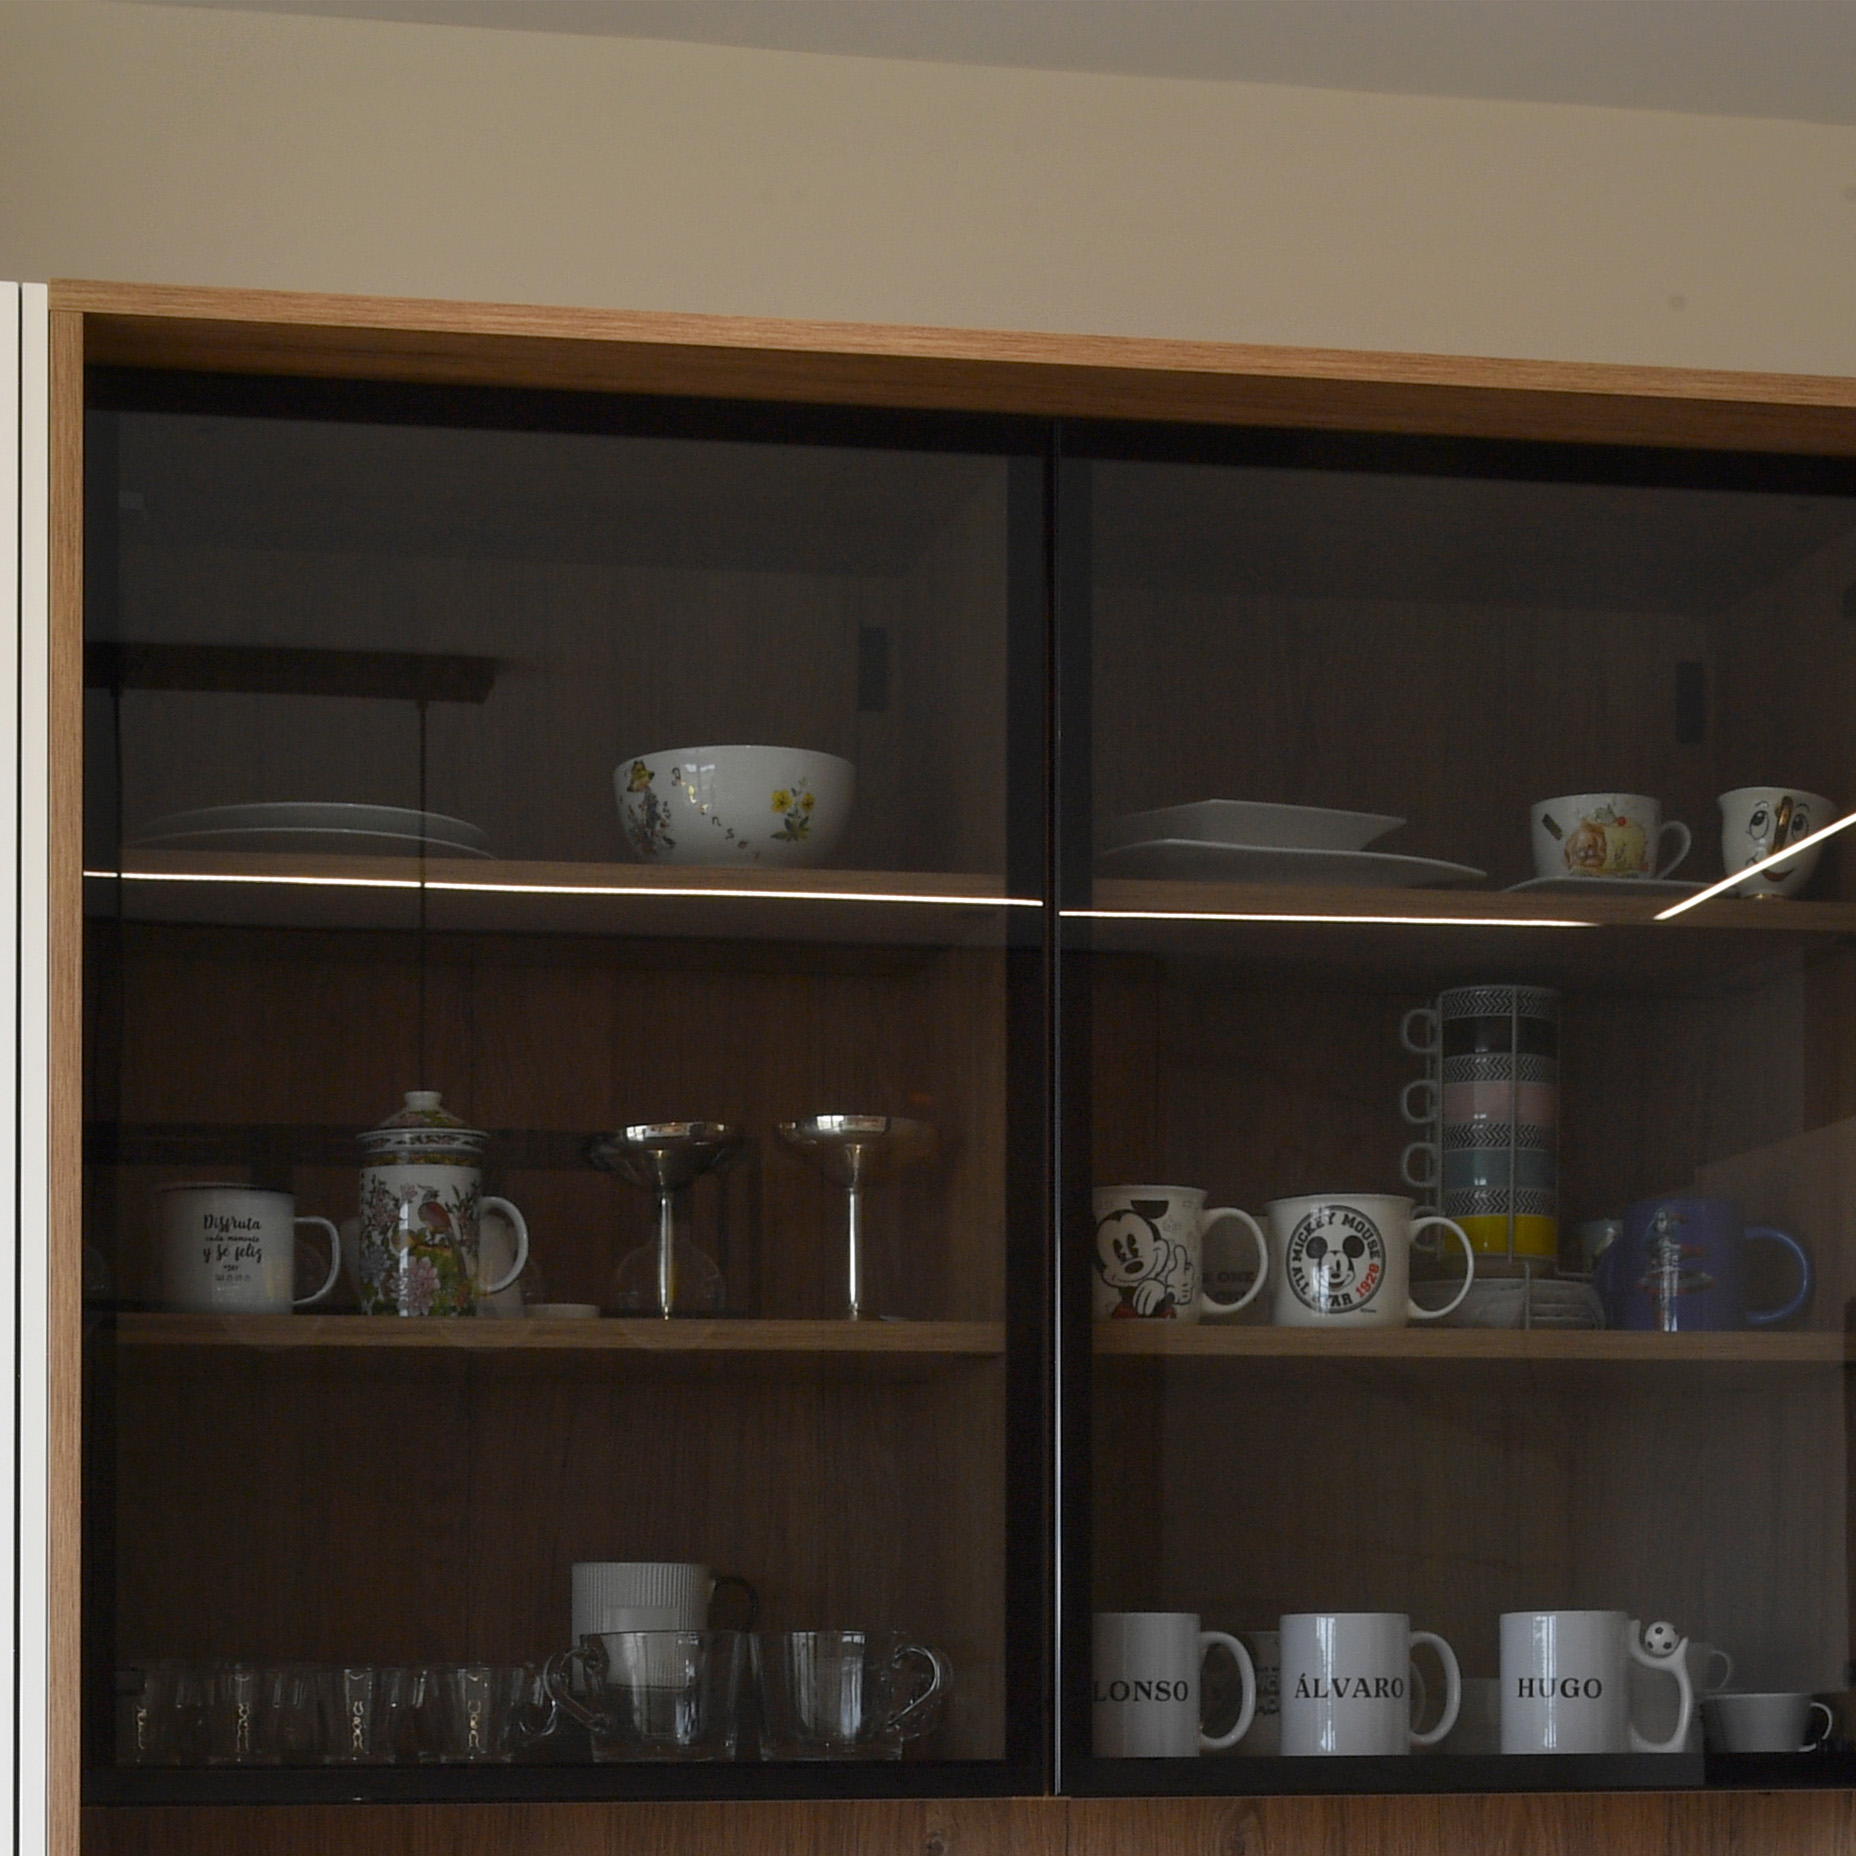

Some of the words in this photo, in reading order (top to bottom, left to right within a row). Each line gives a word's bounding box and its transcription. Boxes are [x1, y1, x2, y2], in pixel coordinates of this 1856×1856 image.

[203, 1214, 262, 1232] Disfruta
[1292, 1211, 1336, 1262] MICKEY
[1340, 1213, 1381, 1260] MOUSE
[203, 1246, 211, 1263] y
[235, 1243, 262, 1263] feliz
[1292, 1265, 1310, 1296] ALL
[1311, 1293, 1354, 1307] TAR
[1356, 1263, 1380, 1299] 1928
[1094, 1680, 1189, 1702] LONSO
[1294, 1672, 1405, 1699] ÁLVARO
[1517, 1677, 1603, 1699] HUGO
